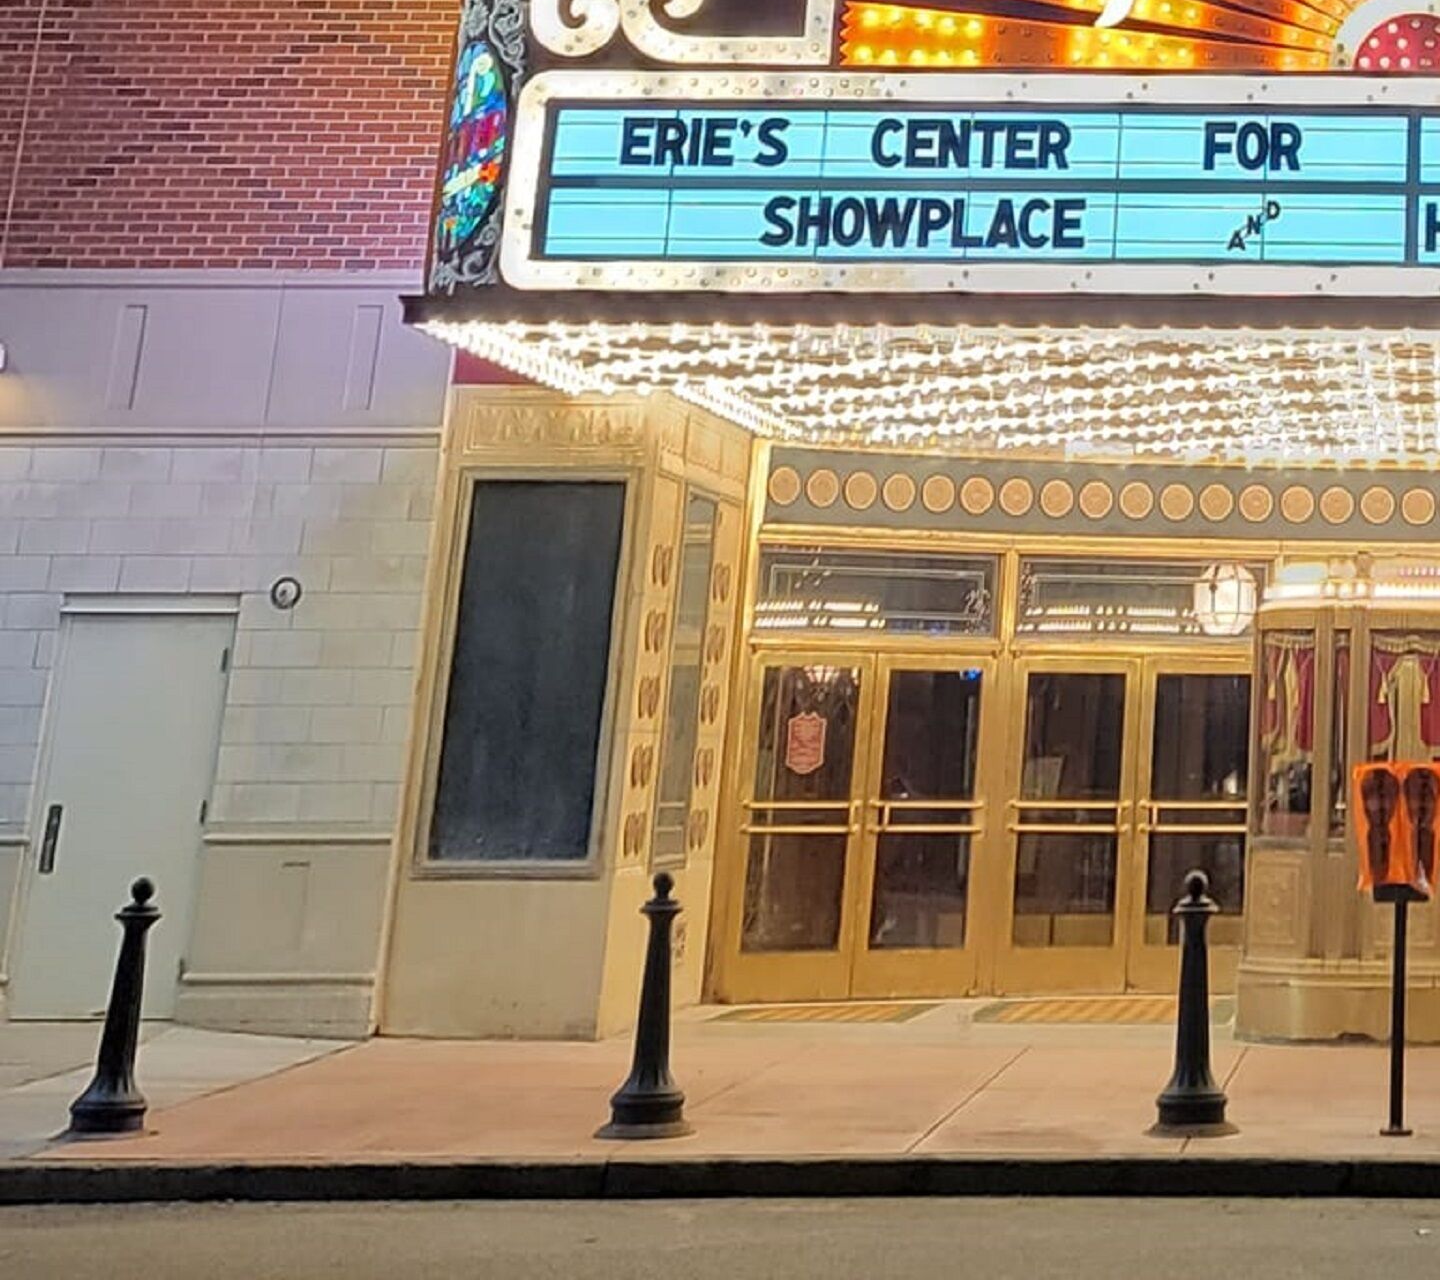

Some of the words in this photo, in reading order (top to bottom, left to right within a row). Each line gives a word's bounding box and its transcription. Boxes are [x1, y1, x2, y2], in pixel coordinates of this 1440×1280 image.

[619, 116, 790, 166] ERIE'S
[871, 119, 1072, 169] CENTER
[1203, 121, 1301, 172] FOR
[759, 195, 1087, 249] SHOWPLACE
[1227, 200, 1281, 251] AND
